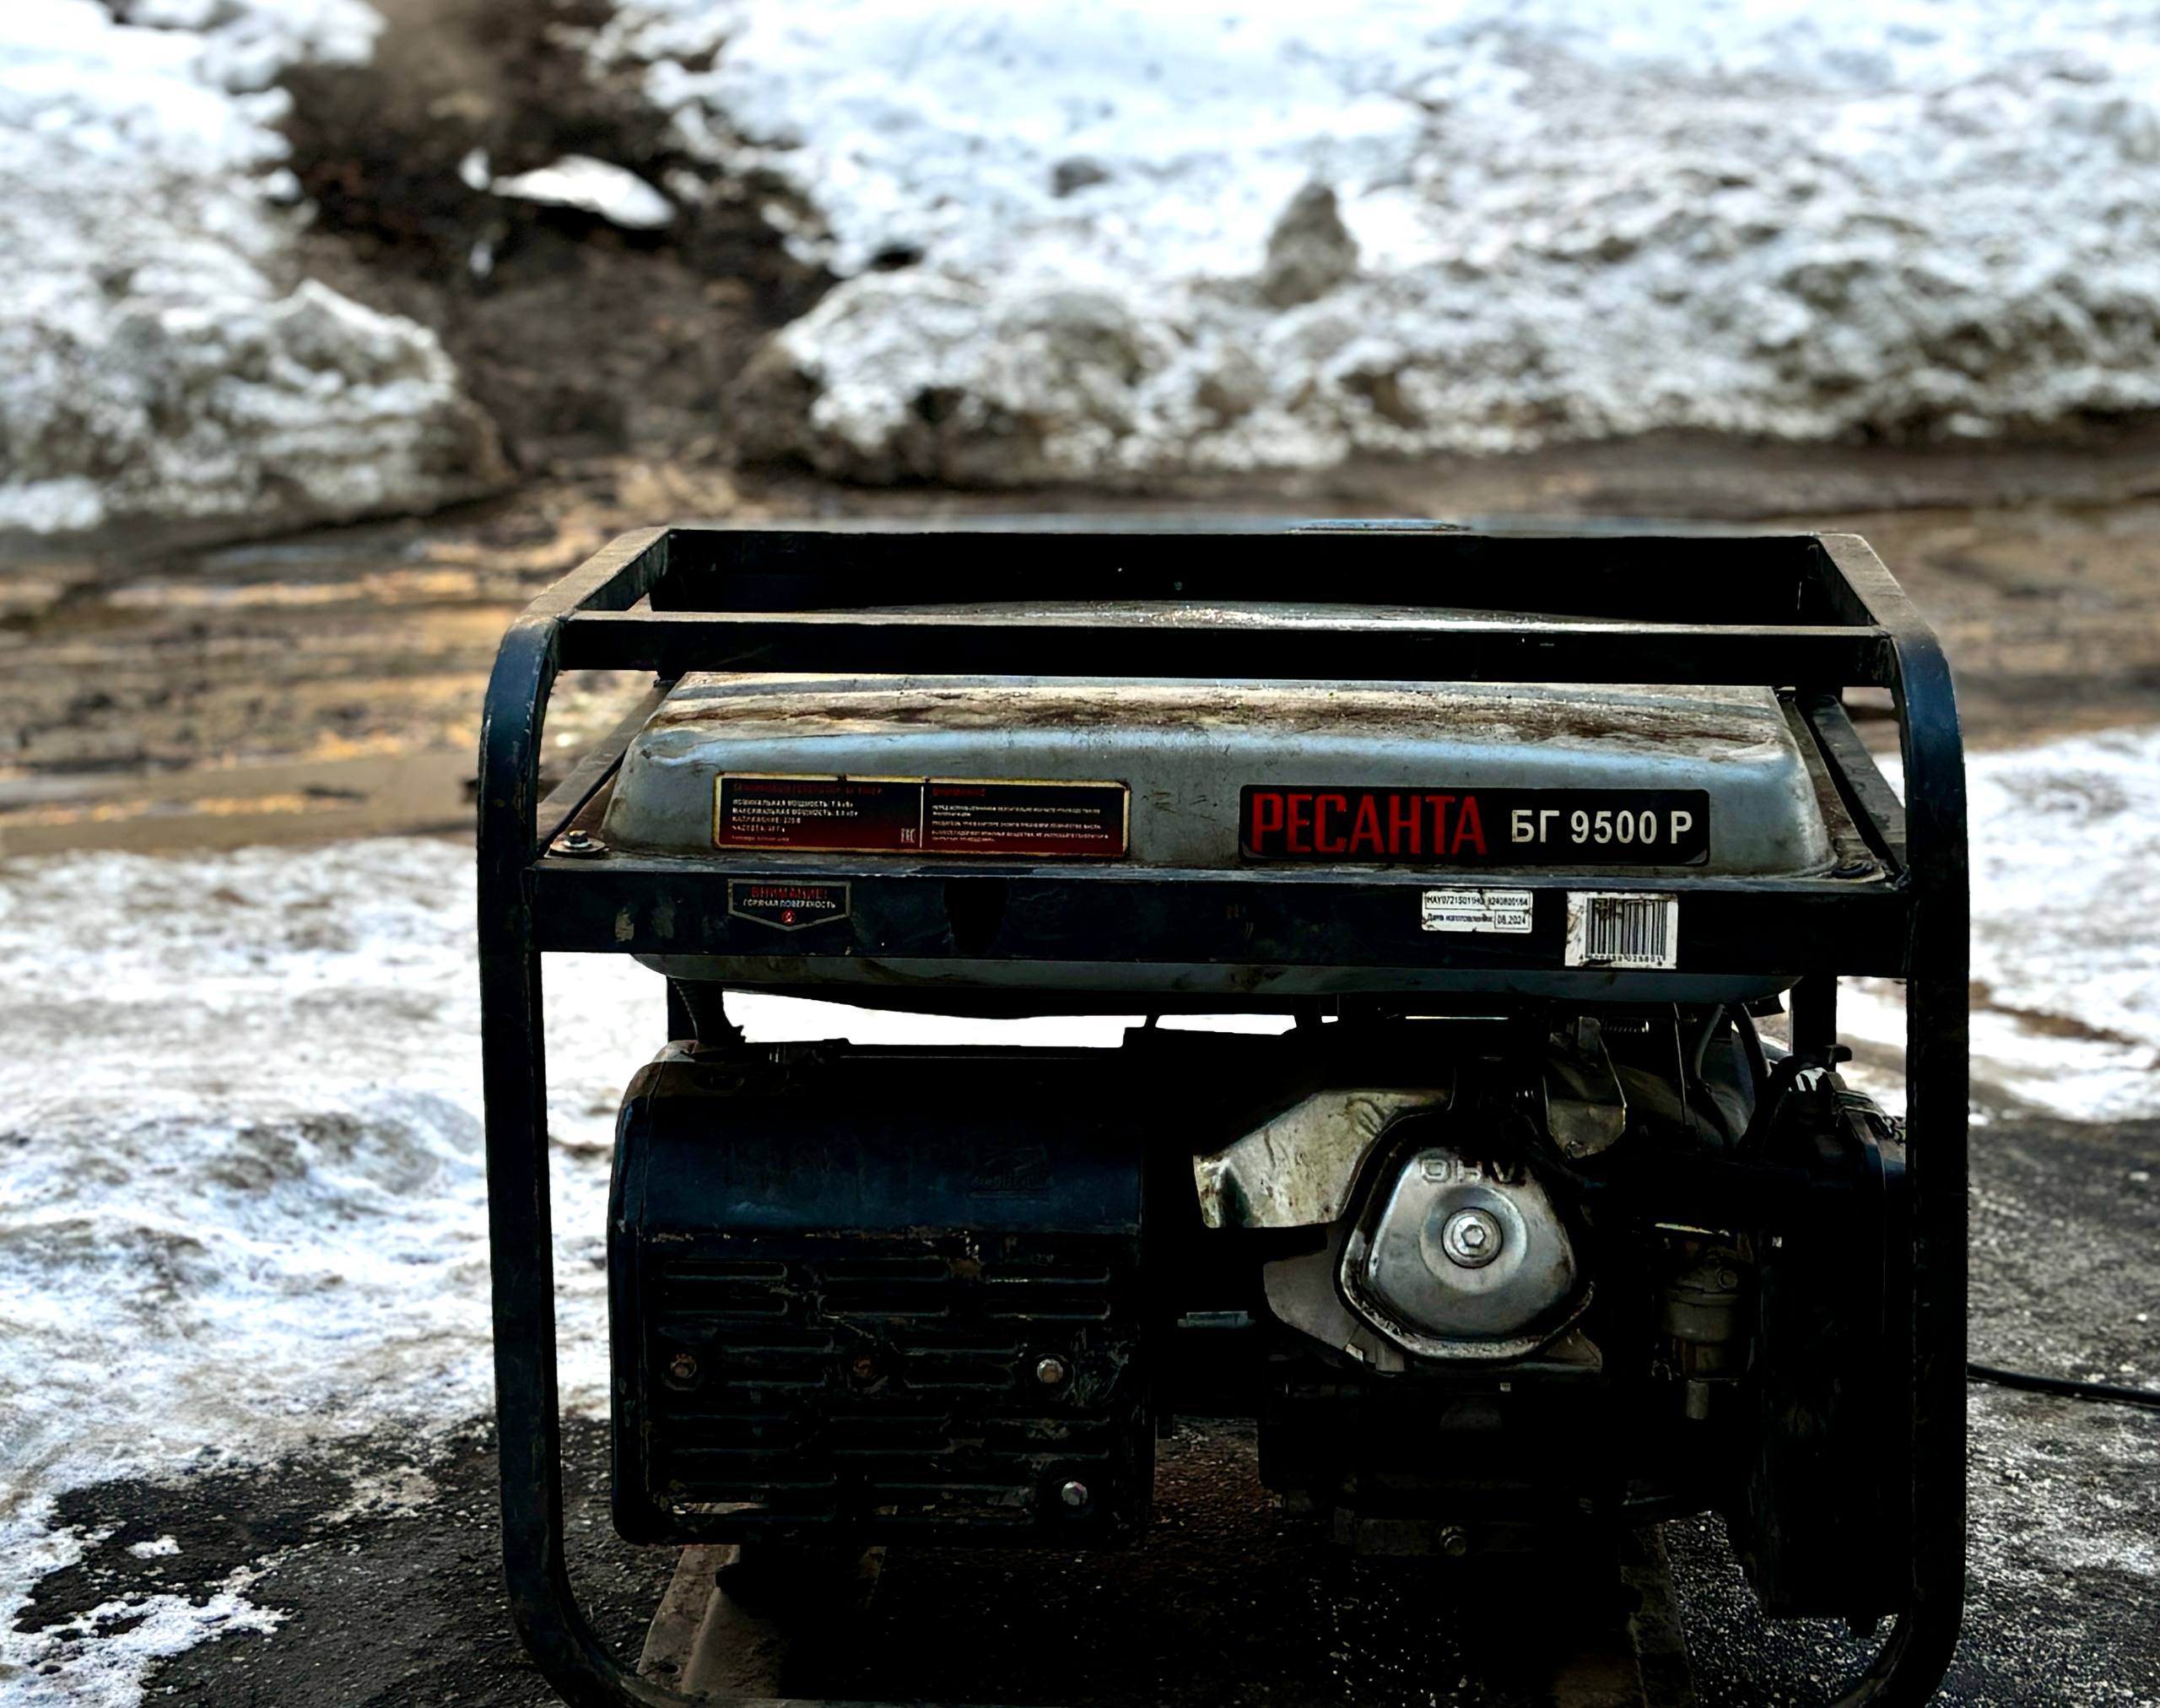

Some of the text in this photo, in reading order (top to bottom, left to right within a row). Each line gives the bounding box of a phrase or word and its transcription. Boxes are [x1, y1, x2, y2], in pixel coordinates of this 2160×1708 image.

[1252, 793, 1693, 856] РЕСАНТА БГ 9500 Р
[1497, 915, 1526, 925] 08.2024
[1422, 1150, 1515, 1183] OHV
